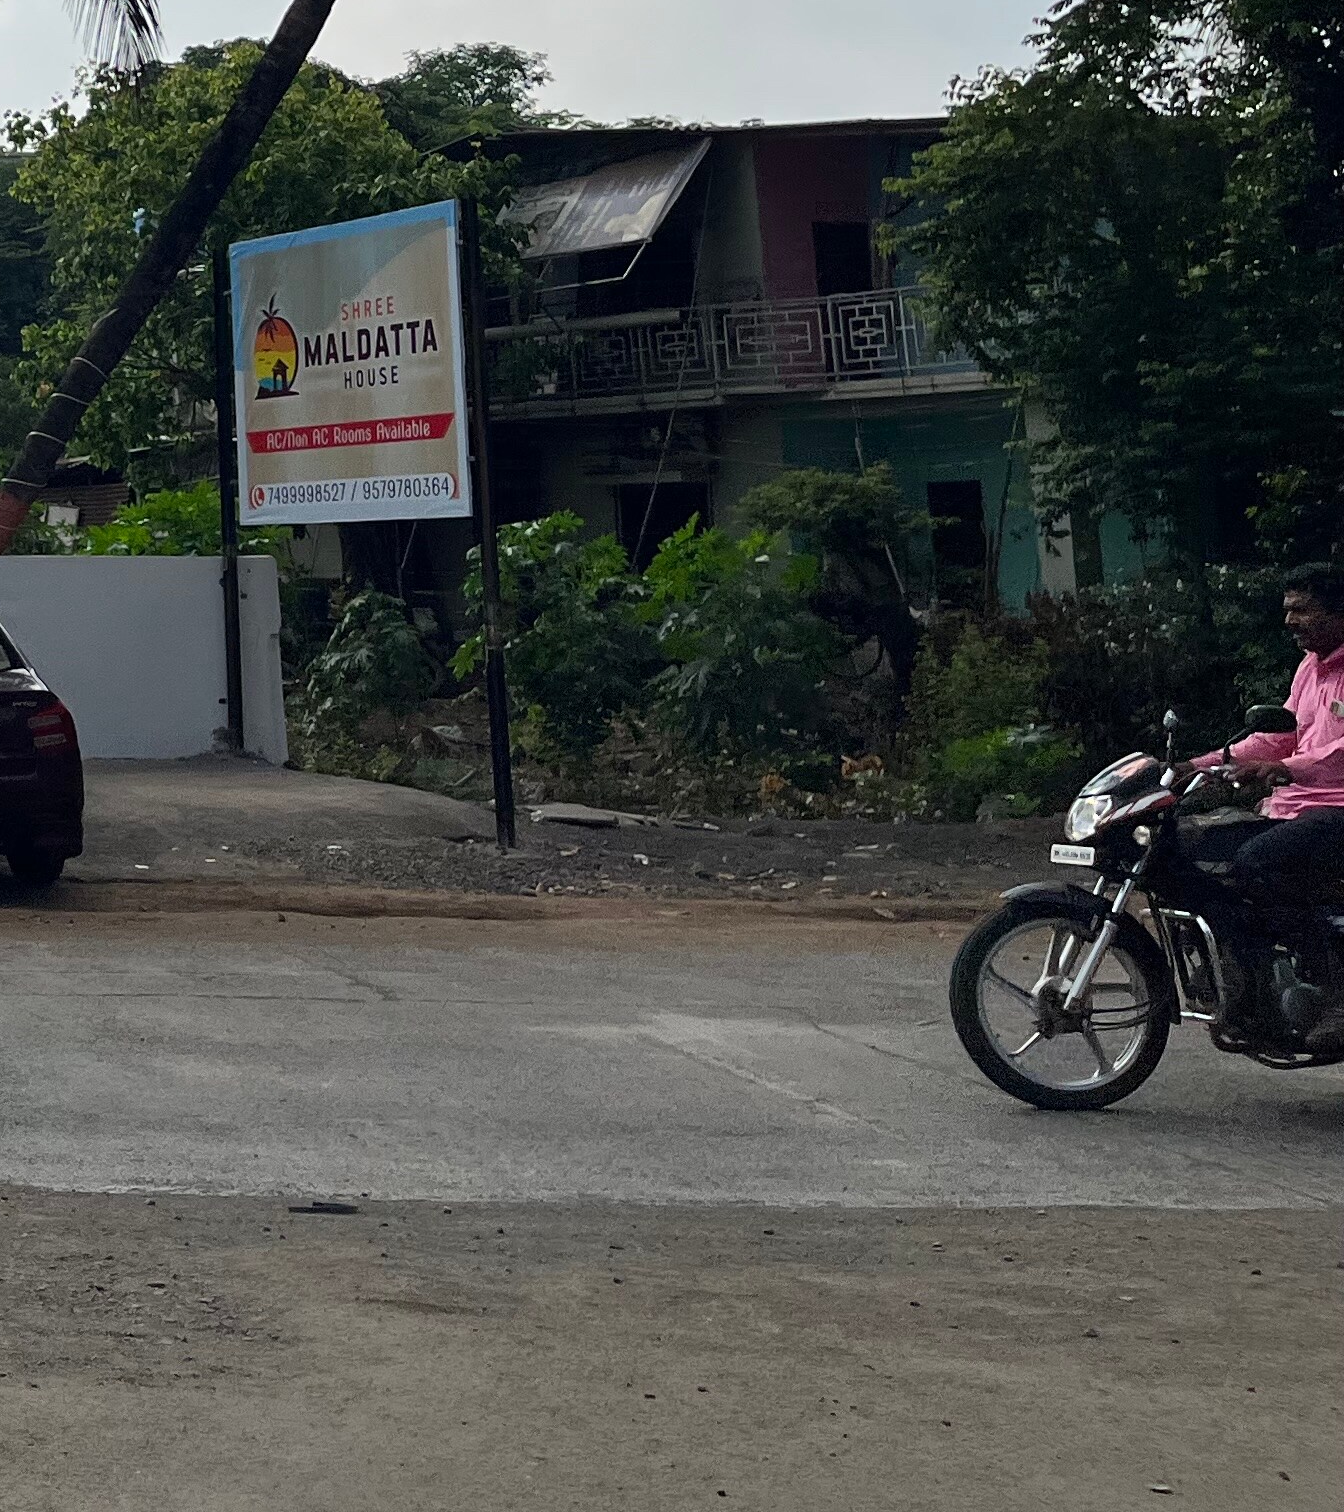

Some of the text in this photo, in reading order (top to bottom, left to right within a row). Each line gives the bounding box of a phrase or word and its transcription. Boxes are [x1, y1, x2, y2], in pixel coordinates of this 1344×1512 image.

[340, 295, 396, 322] SHREE
[303, 318, 439, 369] MALDATTA
[343, 365, 400, 390] HOUSE
[266, 419, 431, 450] AC/Non AC Rooms Available
[267, 482, 347, 506] 7499998527
[363, 477, 450, 501] 9579780364
